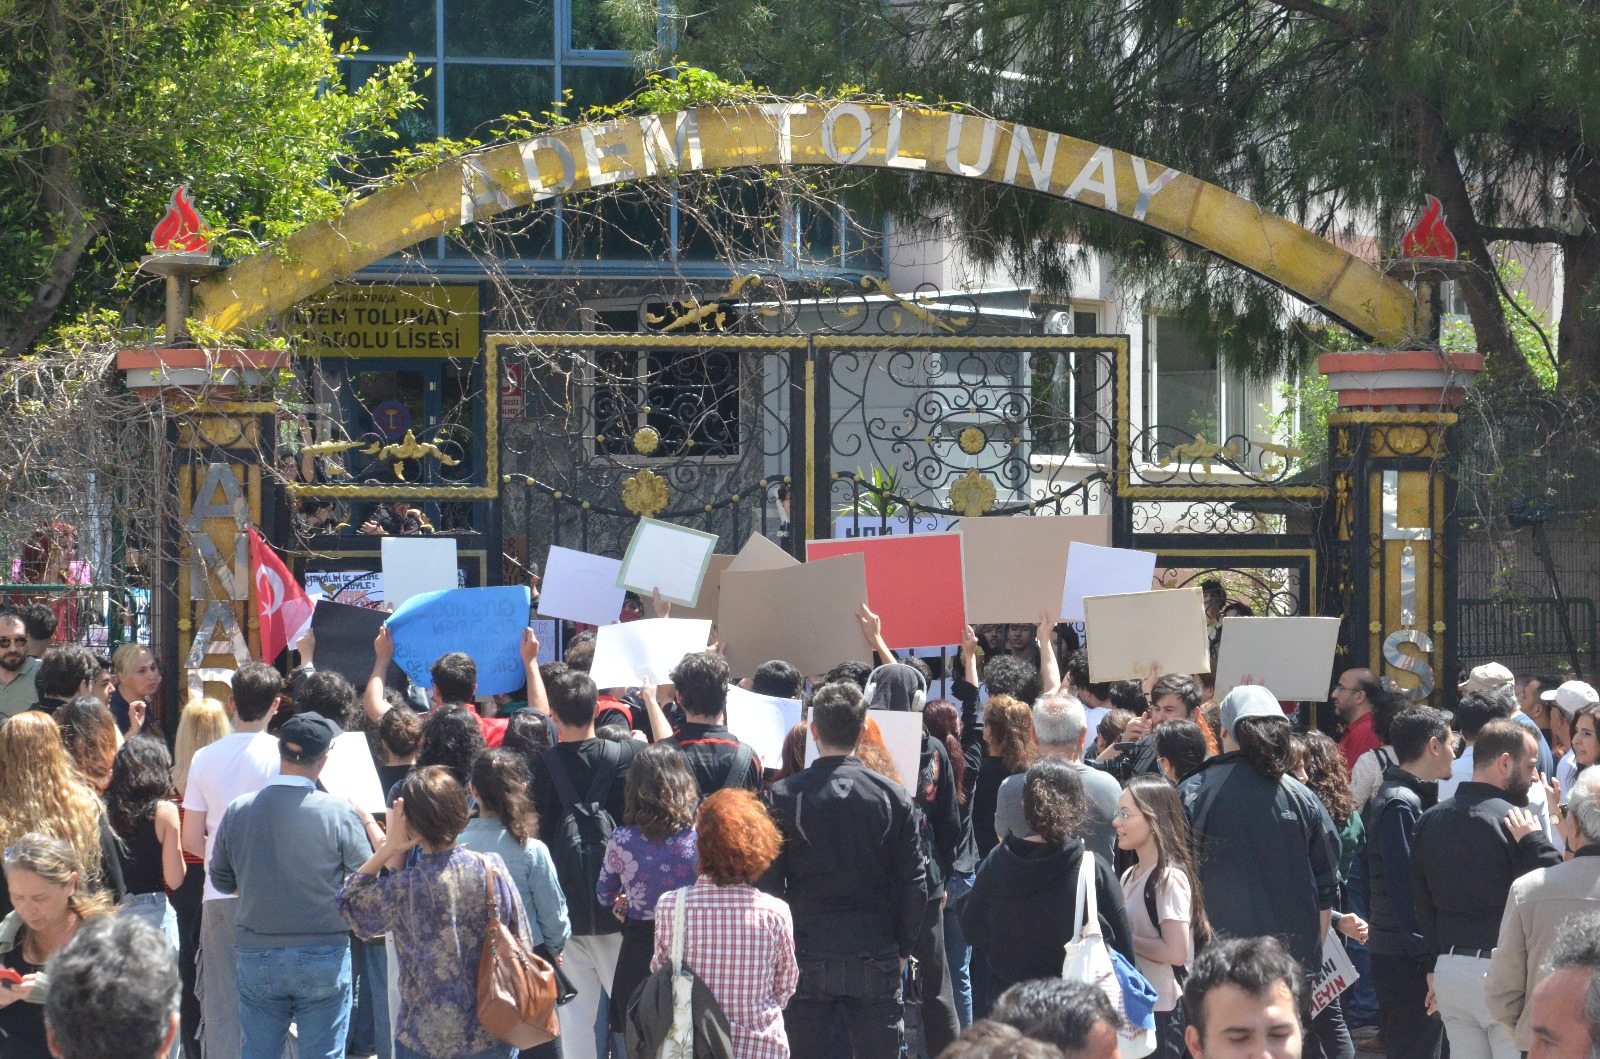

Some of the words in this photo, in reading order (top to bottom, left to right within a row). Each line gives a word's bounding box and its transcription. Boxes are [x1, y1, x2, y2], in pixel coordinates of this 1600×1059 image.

[461, 109, 703, 225] ADEM
[763, 103, 1181, 221] TOLUNAY
[287, 308, 347, 325] ADEM
[354, 308, 450, 325] TOLUNAY
[396, 328, 460, 348] LİSESİ
